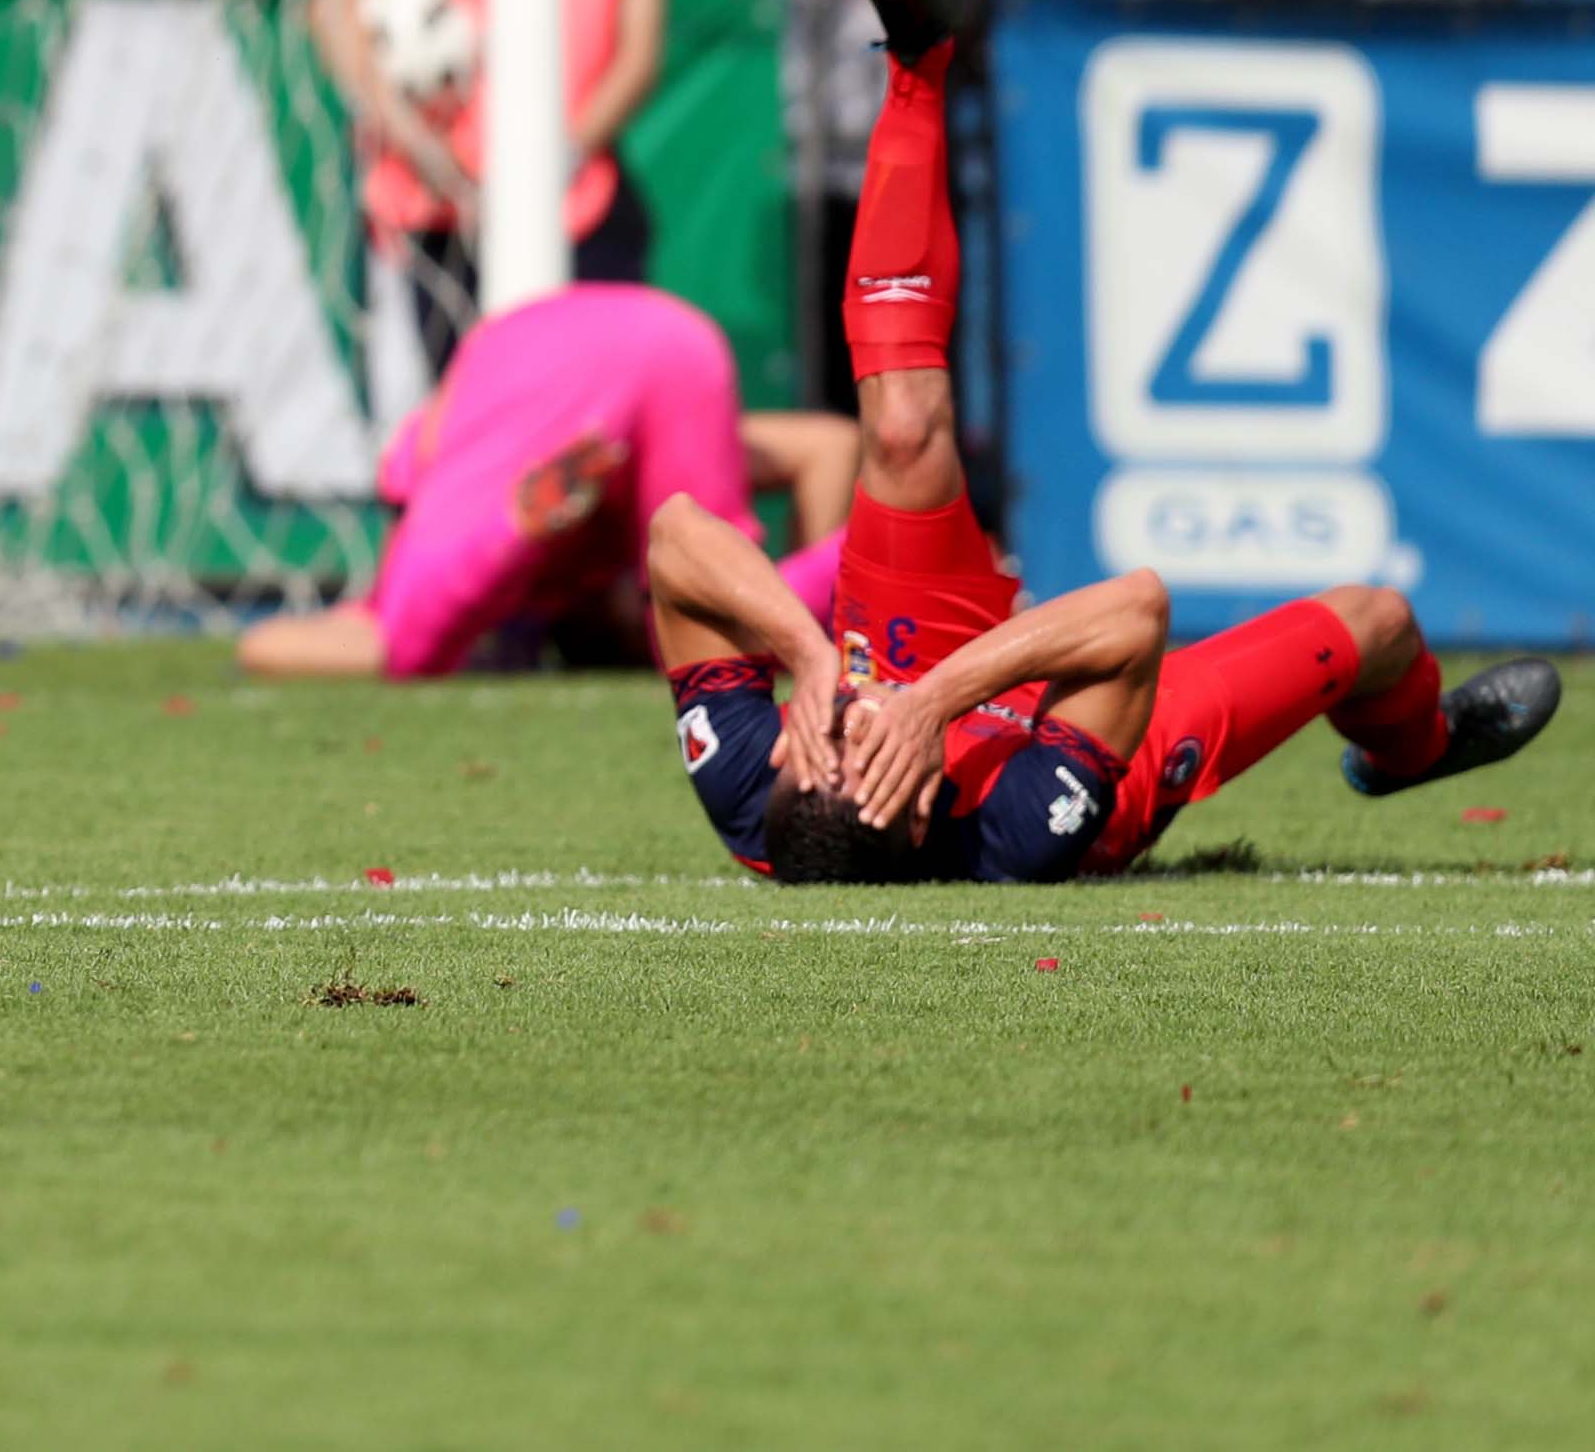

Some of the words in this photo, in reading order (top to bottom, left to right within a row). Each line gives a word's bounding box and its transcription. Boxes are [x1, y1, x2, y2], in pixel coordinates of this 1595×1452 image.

[1136, 106, 1336, 409] Z
[1147, 495, 1340, 548] GAS
[887, 617, 917, 669] 3
